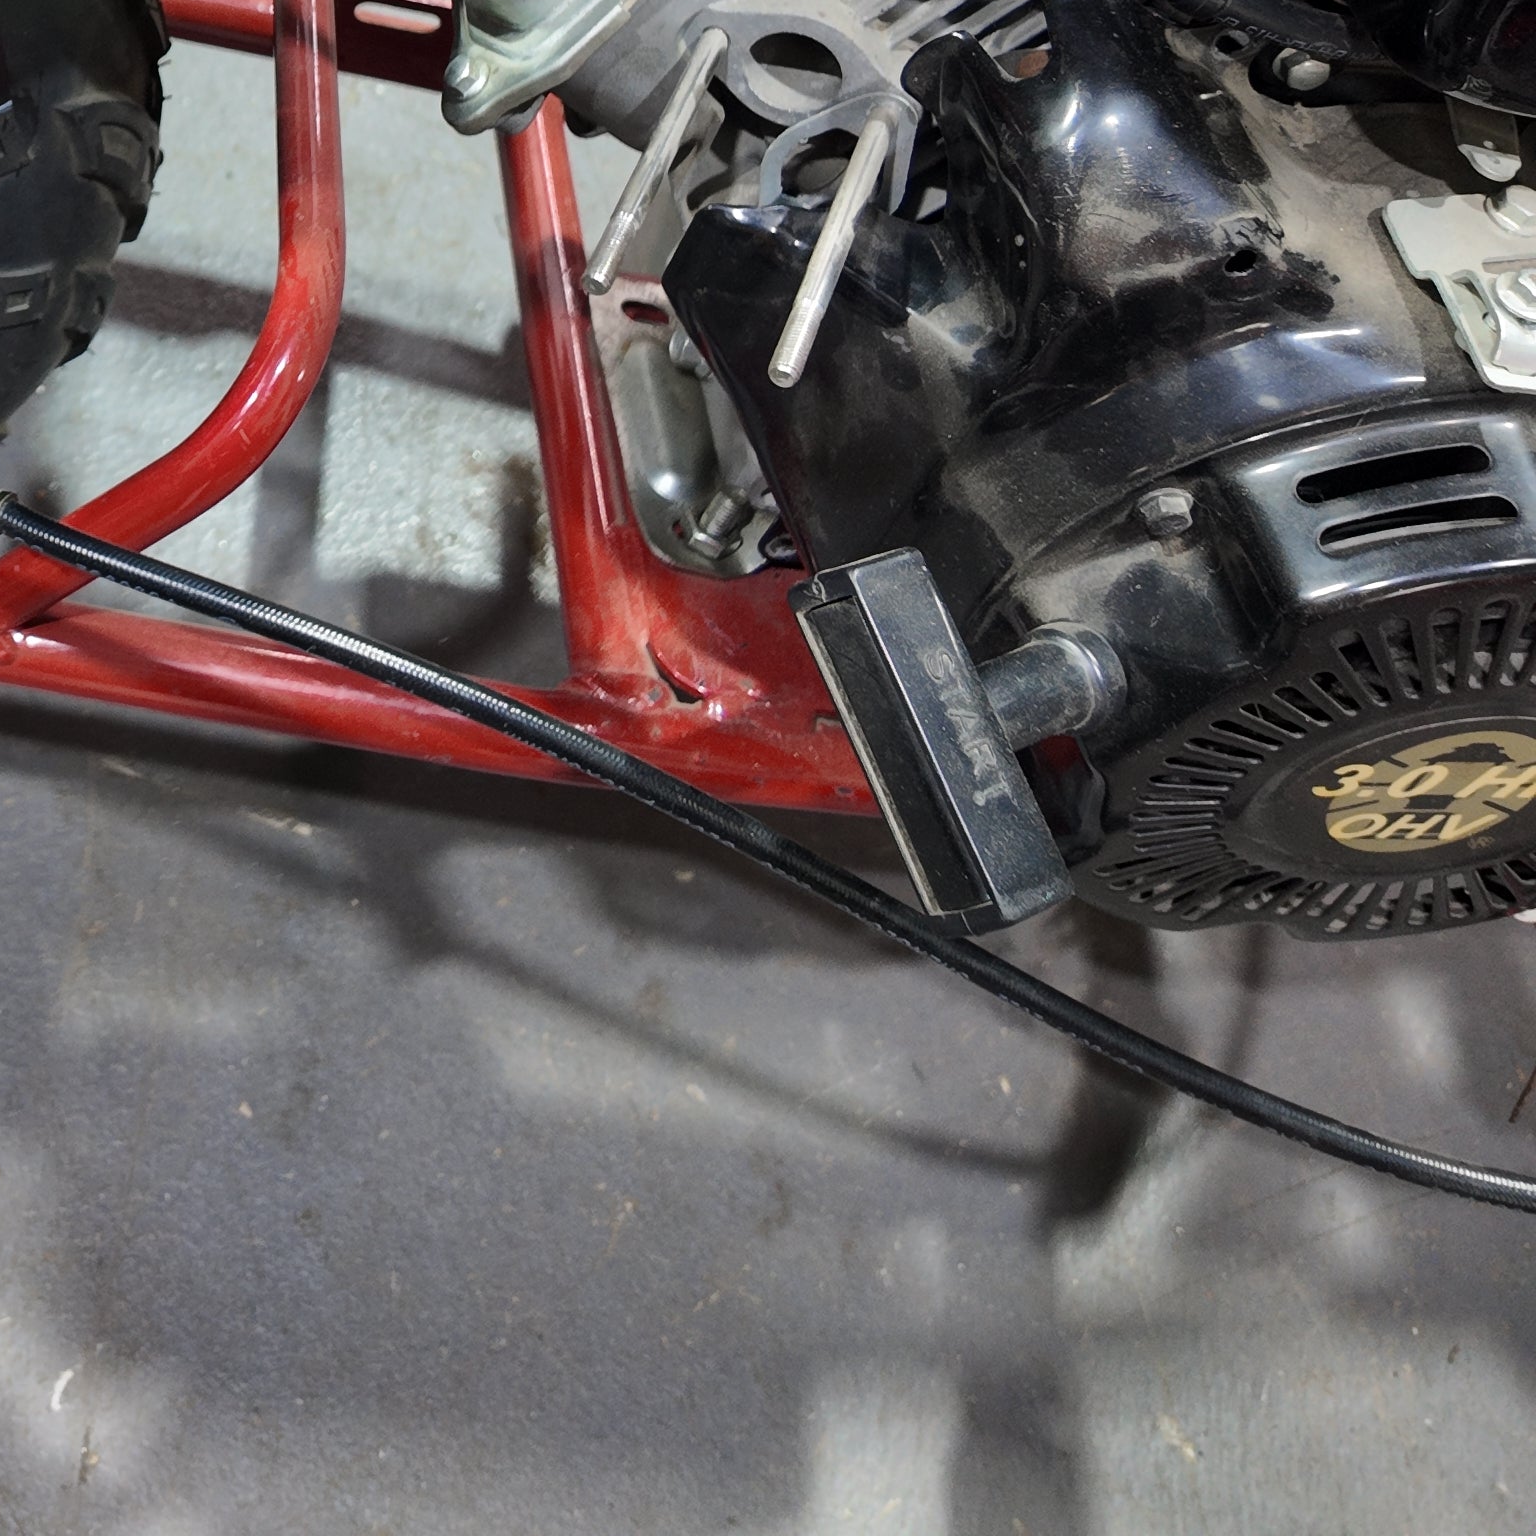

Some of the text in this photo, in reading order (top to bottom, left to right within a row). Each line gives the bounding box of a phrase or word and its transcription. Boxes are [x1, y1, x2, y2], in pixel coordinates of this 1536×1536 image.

[924, 647, 1022, 810] START
[1311, 763, 1536, 799] 3.0 H
[1327, 813, 1500, 841] OHV
